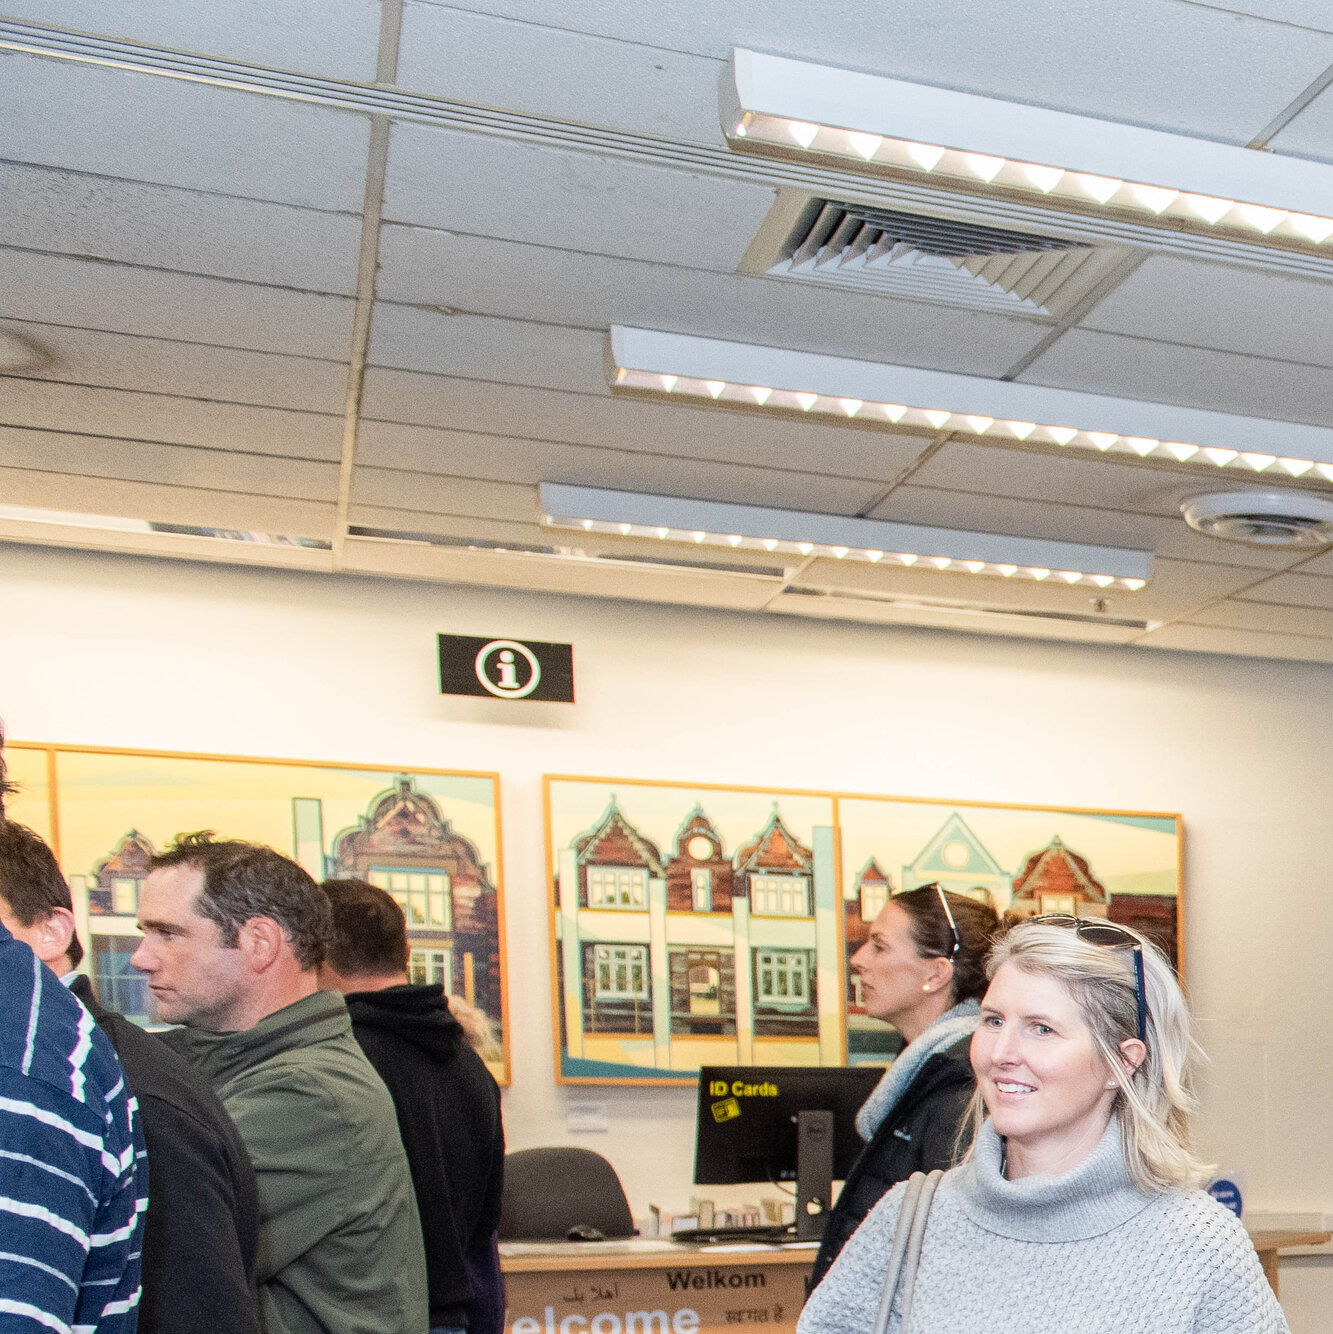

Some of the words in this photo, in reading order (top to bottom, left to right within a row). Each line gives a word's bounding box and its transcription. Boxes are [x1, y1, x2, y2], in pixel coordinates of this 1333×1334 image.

[709, 1081, 728, 1097] ID
[731, 1081, 779, 1098] Cards
[667, 1271, 767, 1291] Welkom
